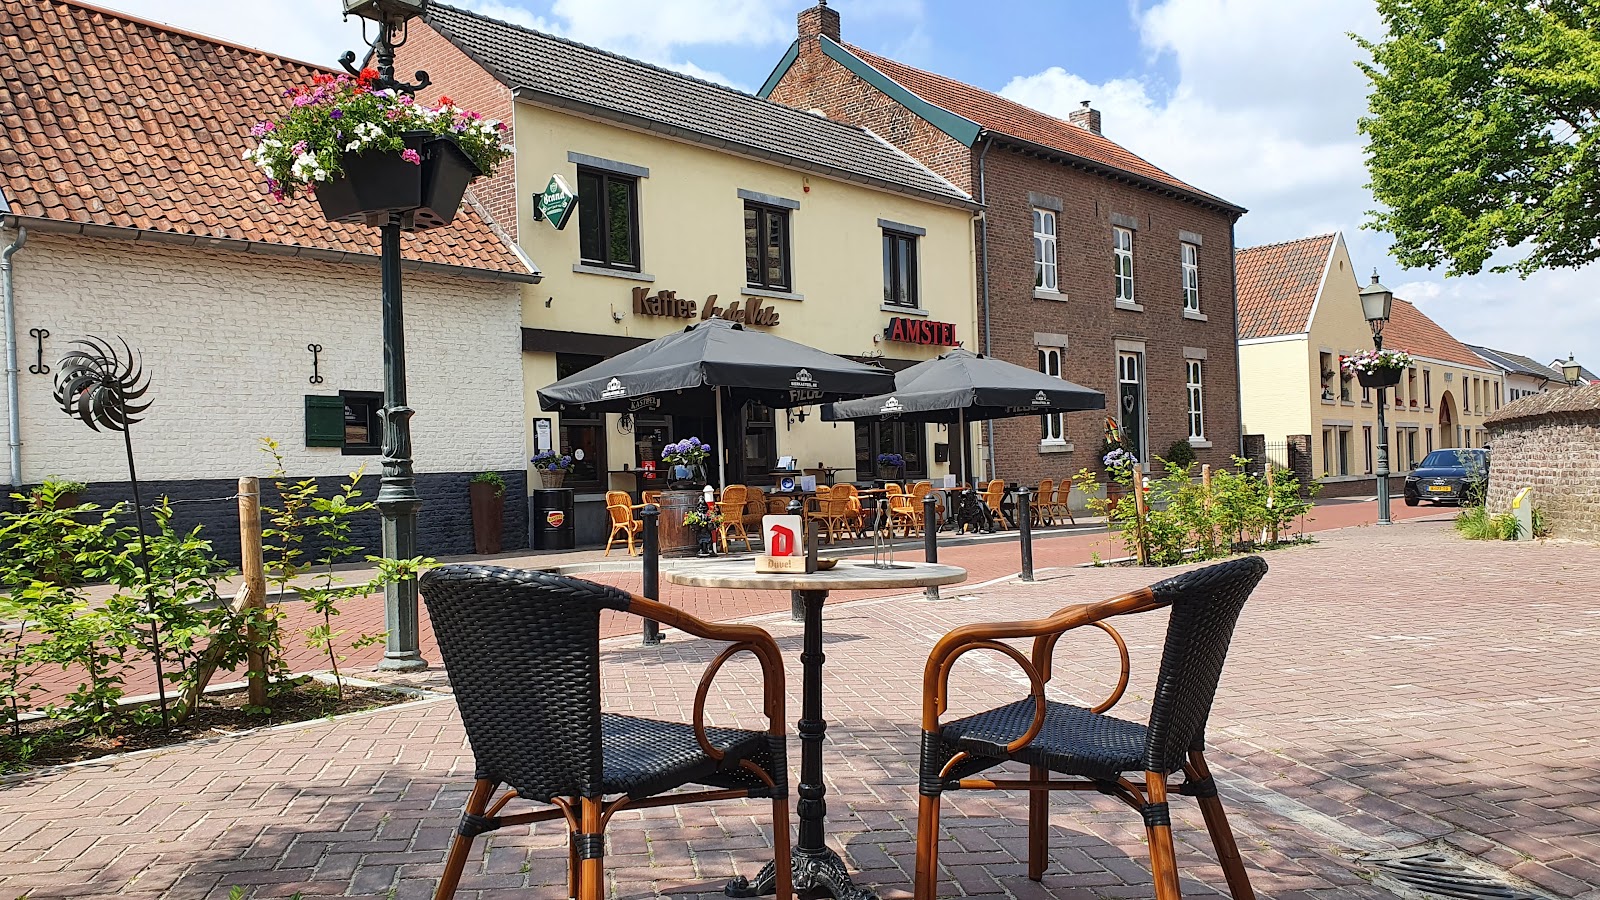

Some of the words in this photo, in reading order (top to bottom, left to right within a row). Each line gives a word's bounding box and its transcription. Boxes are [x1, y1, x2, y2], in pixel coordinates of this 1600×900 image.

[543, 191, 565, 205] Brand
[632, 287, 697, 318] Kaffee
[889, 317, 960, 347] AMSTEL
[767, 558, 792, 569] Duvel
